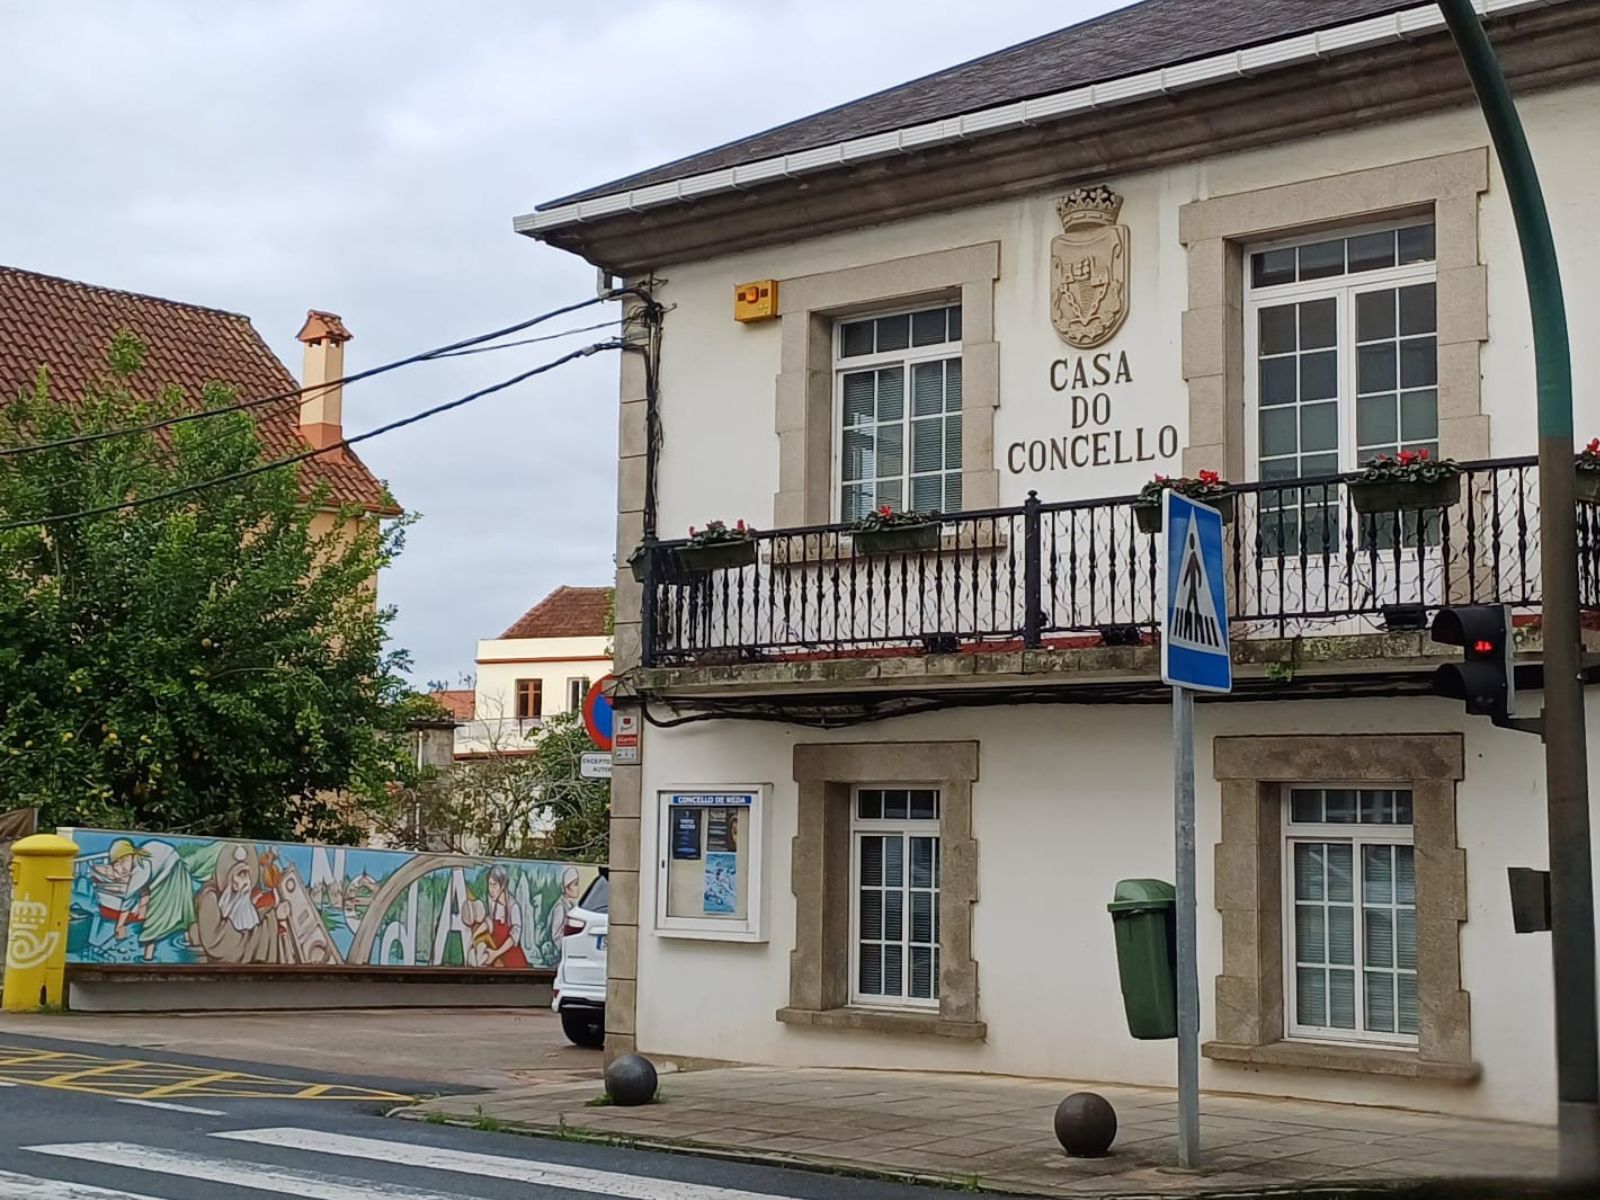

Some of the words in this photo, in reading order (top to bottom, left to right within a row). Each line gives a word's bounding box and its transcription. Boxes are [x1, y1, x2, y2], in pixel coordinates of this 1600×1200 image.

[1050, 351, 1133, 391] CASA
[1071, 393, 1111, 429] DO
[1007, 425, 1178, 474] CONCELLO
[677, 796, 714, 804] CONCELLO
[714, 796, 725, 804] DE
